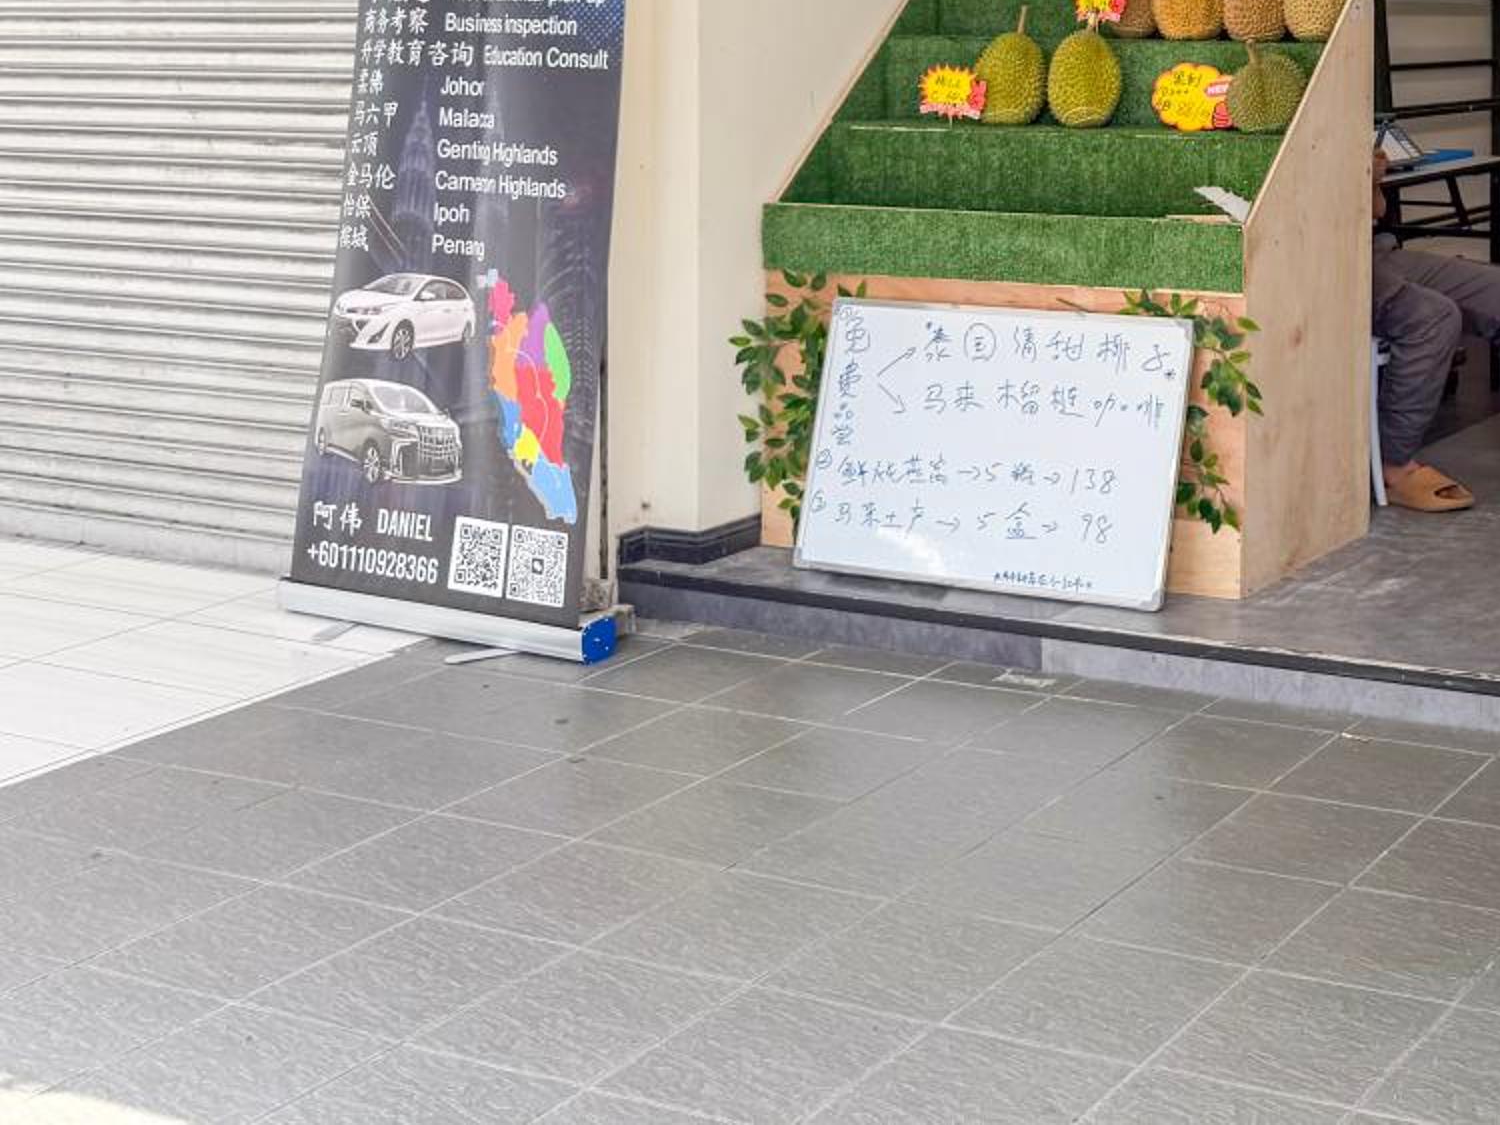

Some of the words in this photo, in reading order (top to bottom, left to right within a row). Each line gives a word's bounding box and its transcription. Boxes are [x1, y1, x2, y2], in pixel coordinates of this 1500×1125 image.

[505, 13, 577, 37] inspection
[547, 47, 608, 69] Consult
[440, 76, 485, 96] Johor
[354, 100, 398, 127] 马六甲
[493, 142, 558, 167] Highlands
[499, 175, 567, 200] Highlands
[433, 203, 470, 226] Ipoh
[1070, 467, 1116, 495] 138
[313, 500, 363, 536] 阿伟
[376, 508, 433, 542] DANIEL
[307, 540, 439, 584] +601110928366
